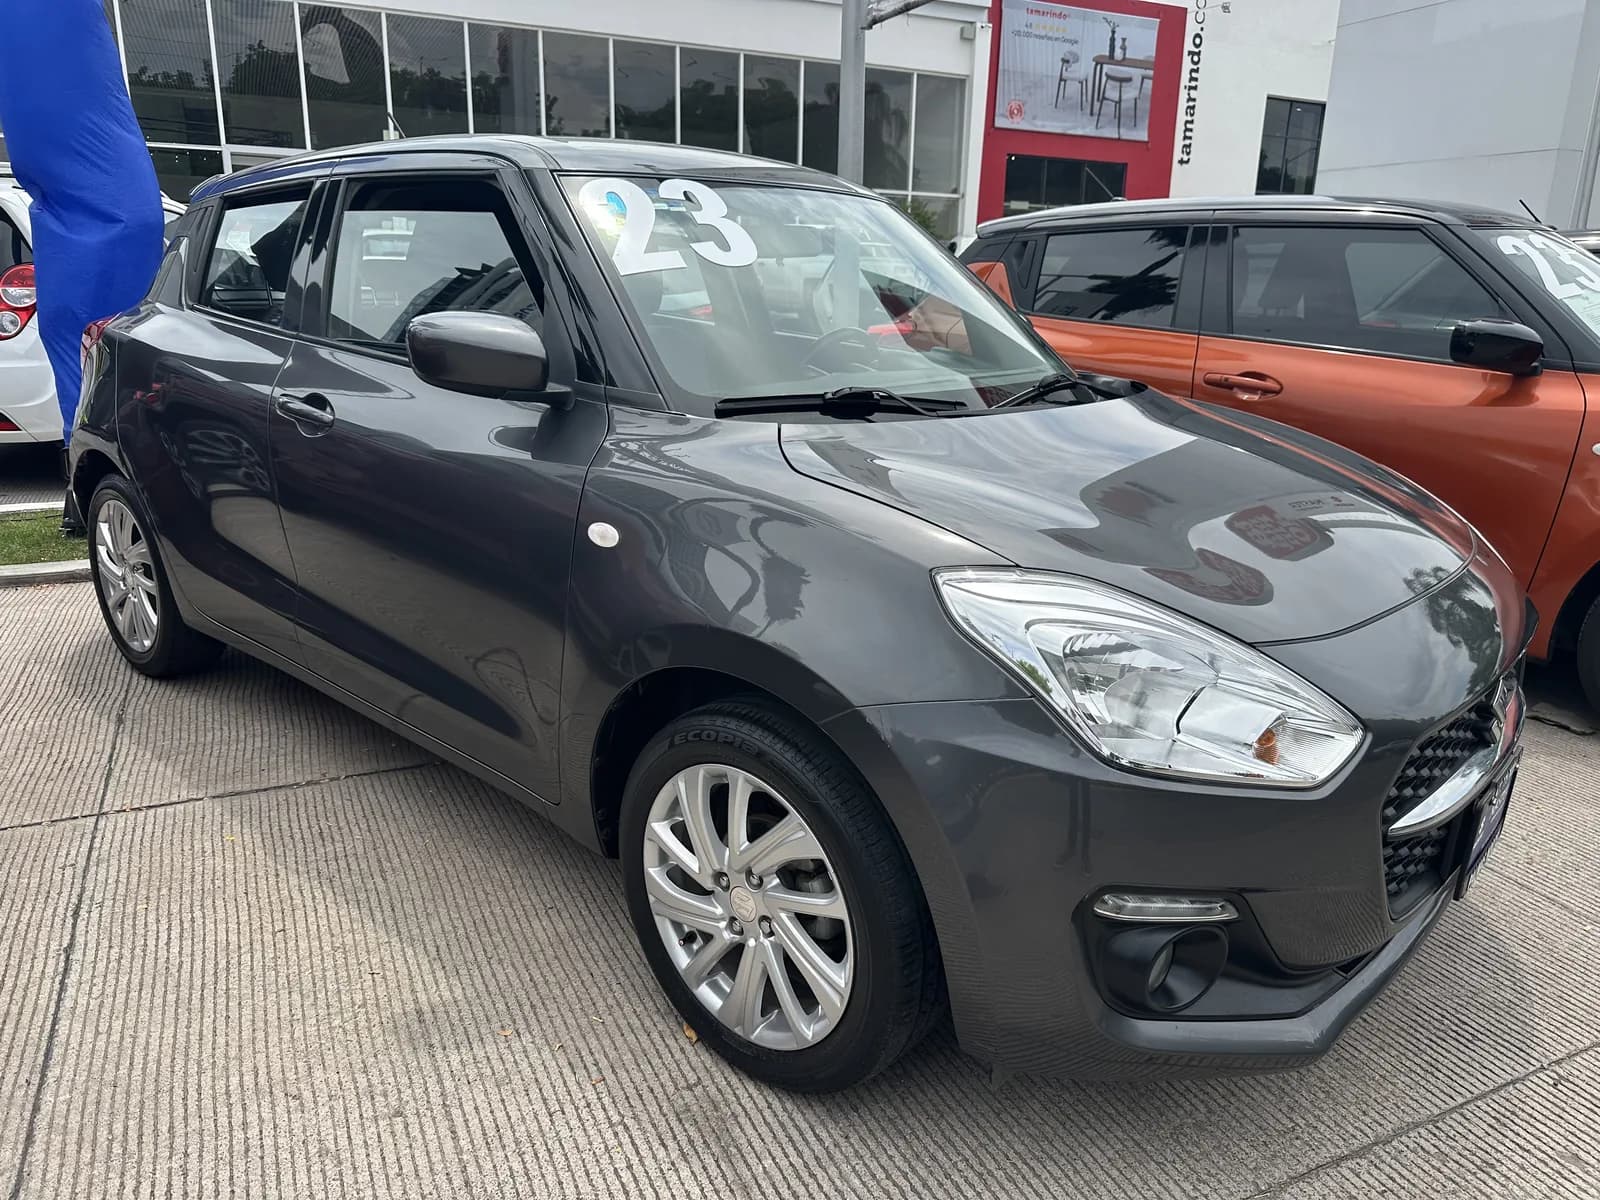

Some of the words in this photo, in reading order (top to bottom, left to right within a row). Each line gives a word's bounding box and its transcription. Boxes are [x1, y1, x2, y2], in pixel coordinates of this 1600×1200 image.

[1026, 7, 1068, 20] tamarindo
[1061, 36, 1079, 46] Google
[578, 177, 758, 276] 23
[1497, 234, 1600, 300] 23
